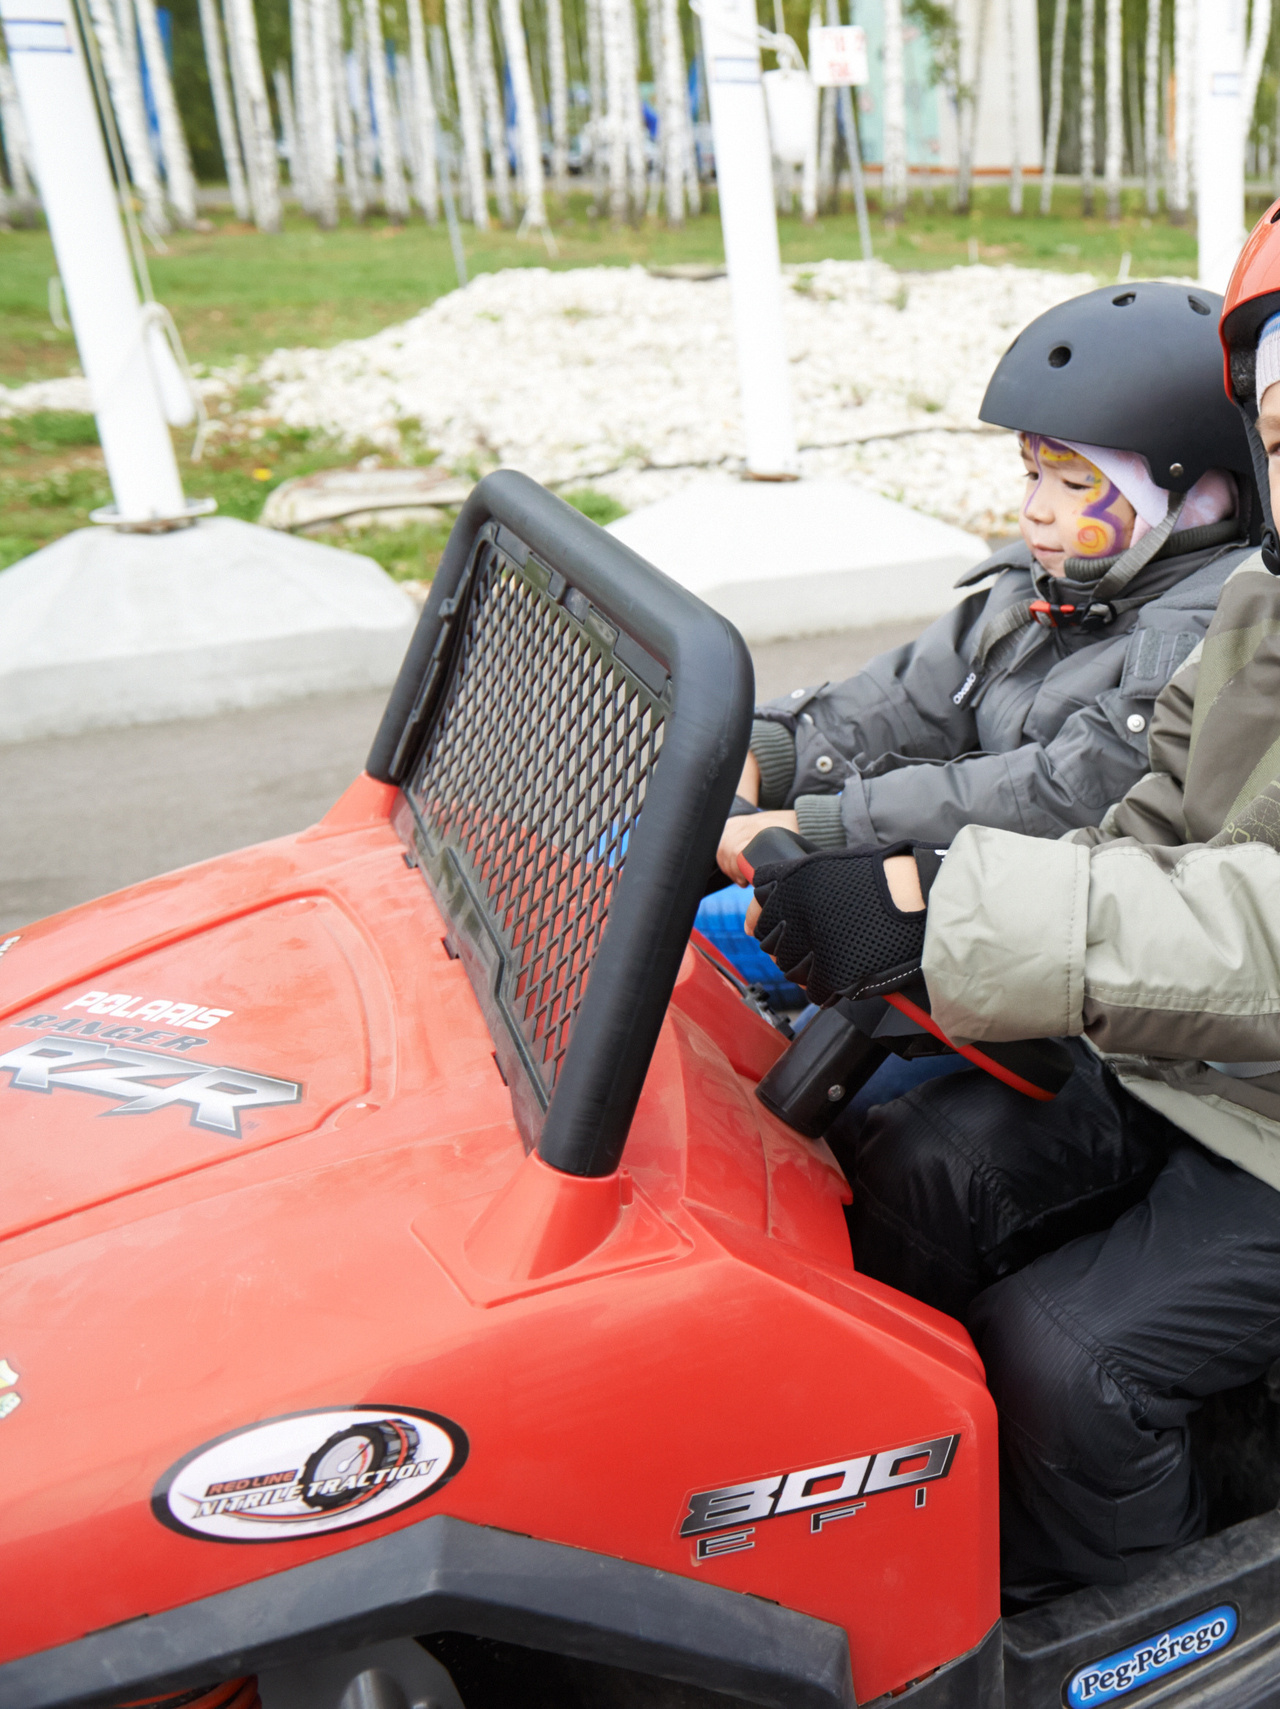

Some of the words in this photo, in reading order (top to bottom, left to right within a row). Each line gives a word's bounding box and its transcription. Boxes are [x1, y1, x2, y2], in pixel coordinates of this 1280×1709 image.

[10, 1014, 209, 1052] RANGER
[62, 991, 234, 1030] POLARIS
[0, 1034, 304, 1140] RZR
[192, 1484, 304, 1519] NITRILE
[307, 1458, 440, 1498] TRACTION
[679, 1434, 961, 1539] 800
[1080, 1618, 1228, 1701] Peg-Pérego
